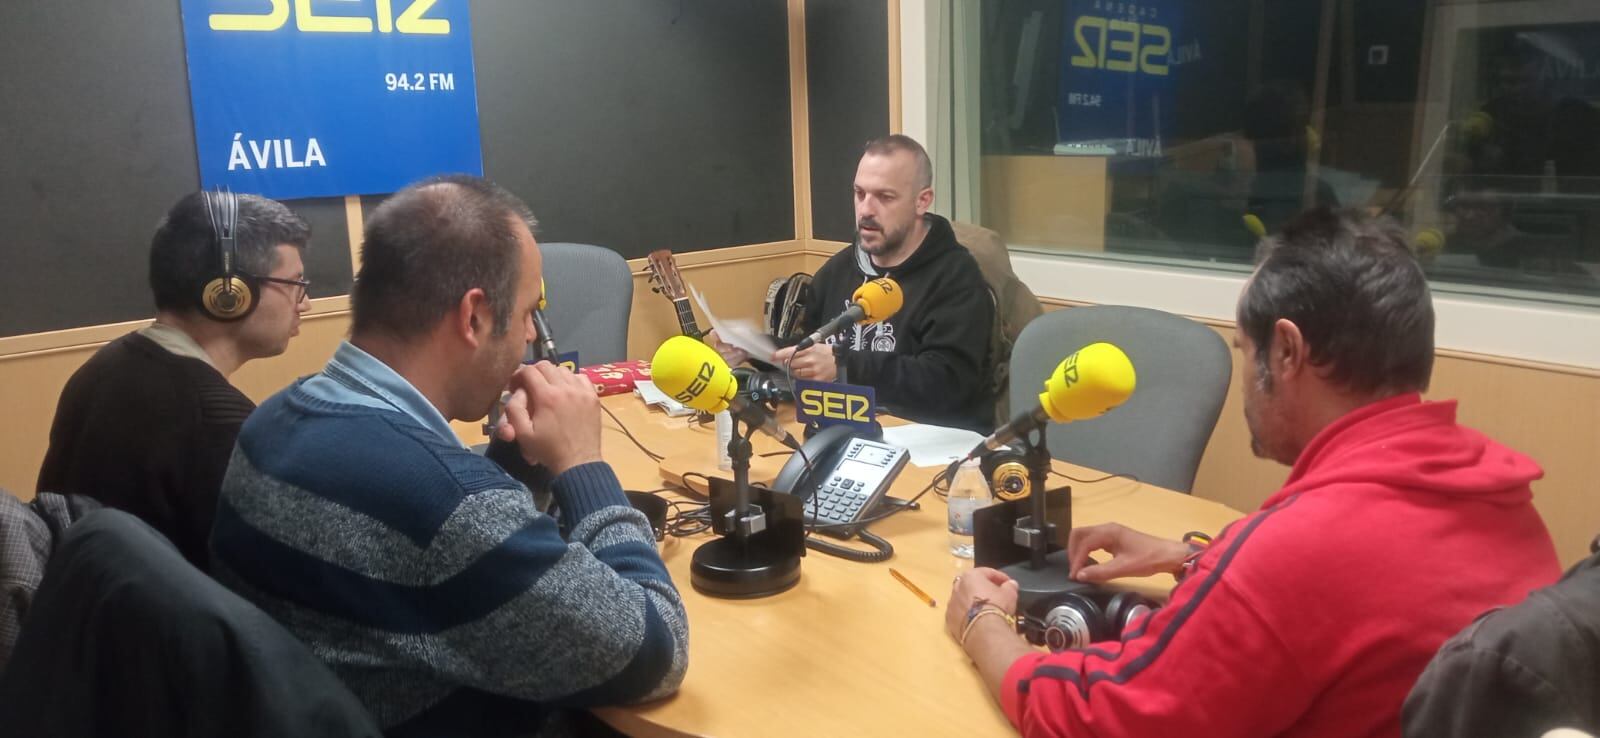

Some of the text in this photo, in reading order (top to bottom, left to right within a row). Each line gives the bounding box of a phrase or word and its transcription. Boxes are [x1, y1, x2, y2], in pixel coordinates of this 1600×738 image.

[384, 72, 455, 91] 94.2 FM
[227, 132, 327, 171] ÁVILA
[675, 361, 716, 404] SER
[1064, 351, 1080, 389] ER
[800, 389, 871, 423] SER
